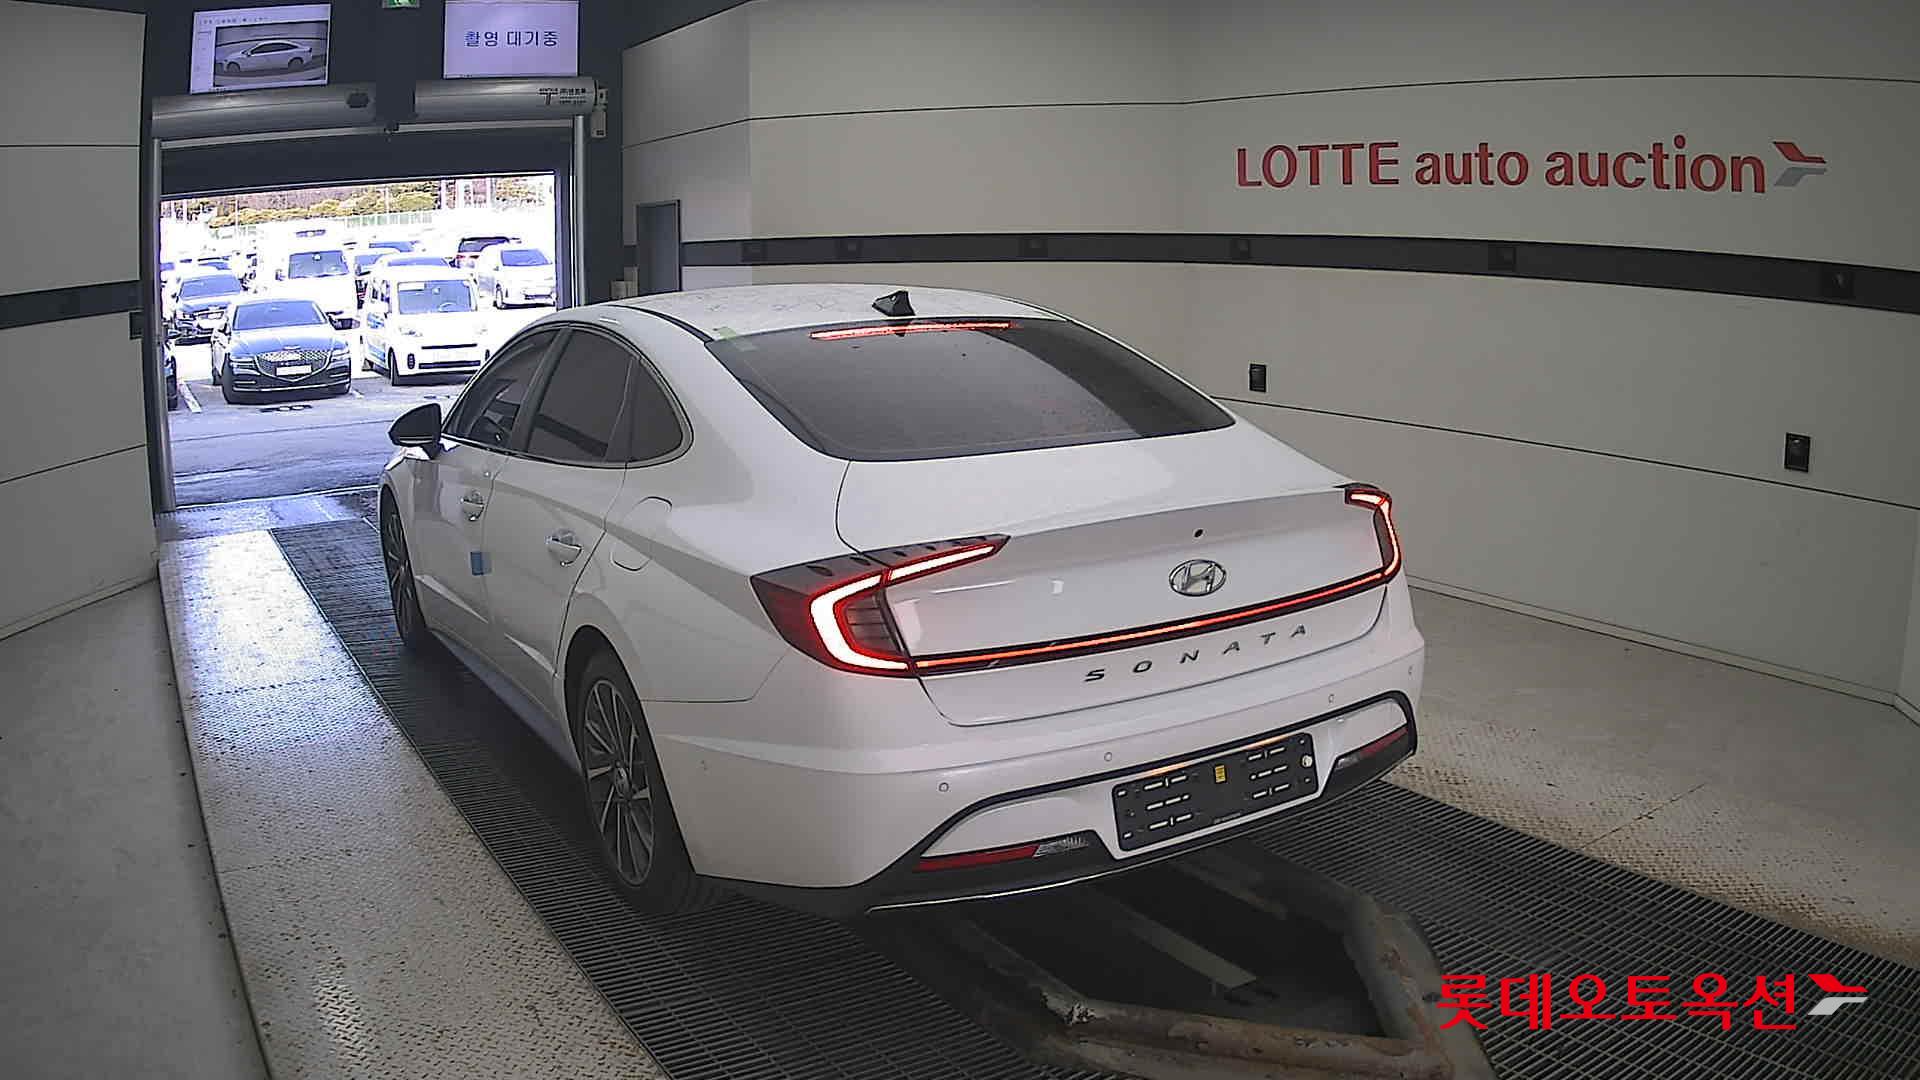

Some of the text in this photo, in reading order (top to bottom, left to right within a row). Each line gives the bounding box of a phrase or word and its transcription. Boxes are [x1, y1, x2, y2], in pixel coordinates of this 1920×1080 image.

[464, 31, 499, 47] 촬영
[1236, 134, 1767, 193] LOTTE auto auction
[1084, 624, 1308, 683] SONATA
